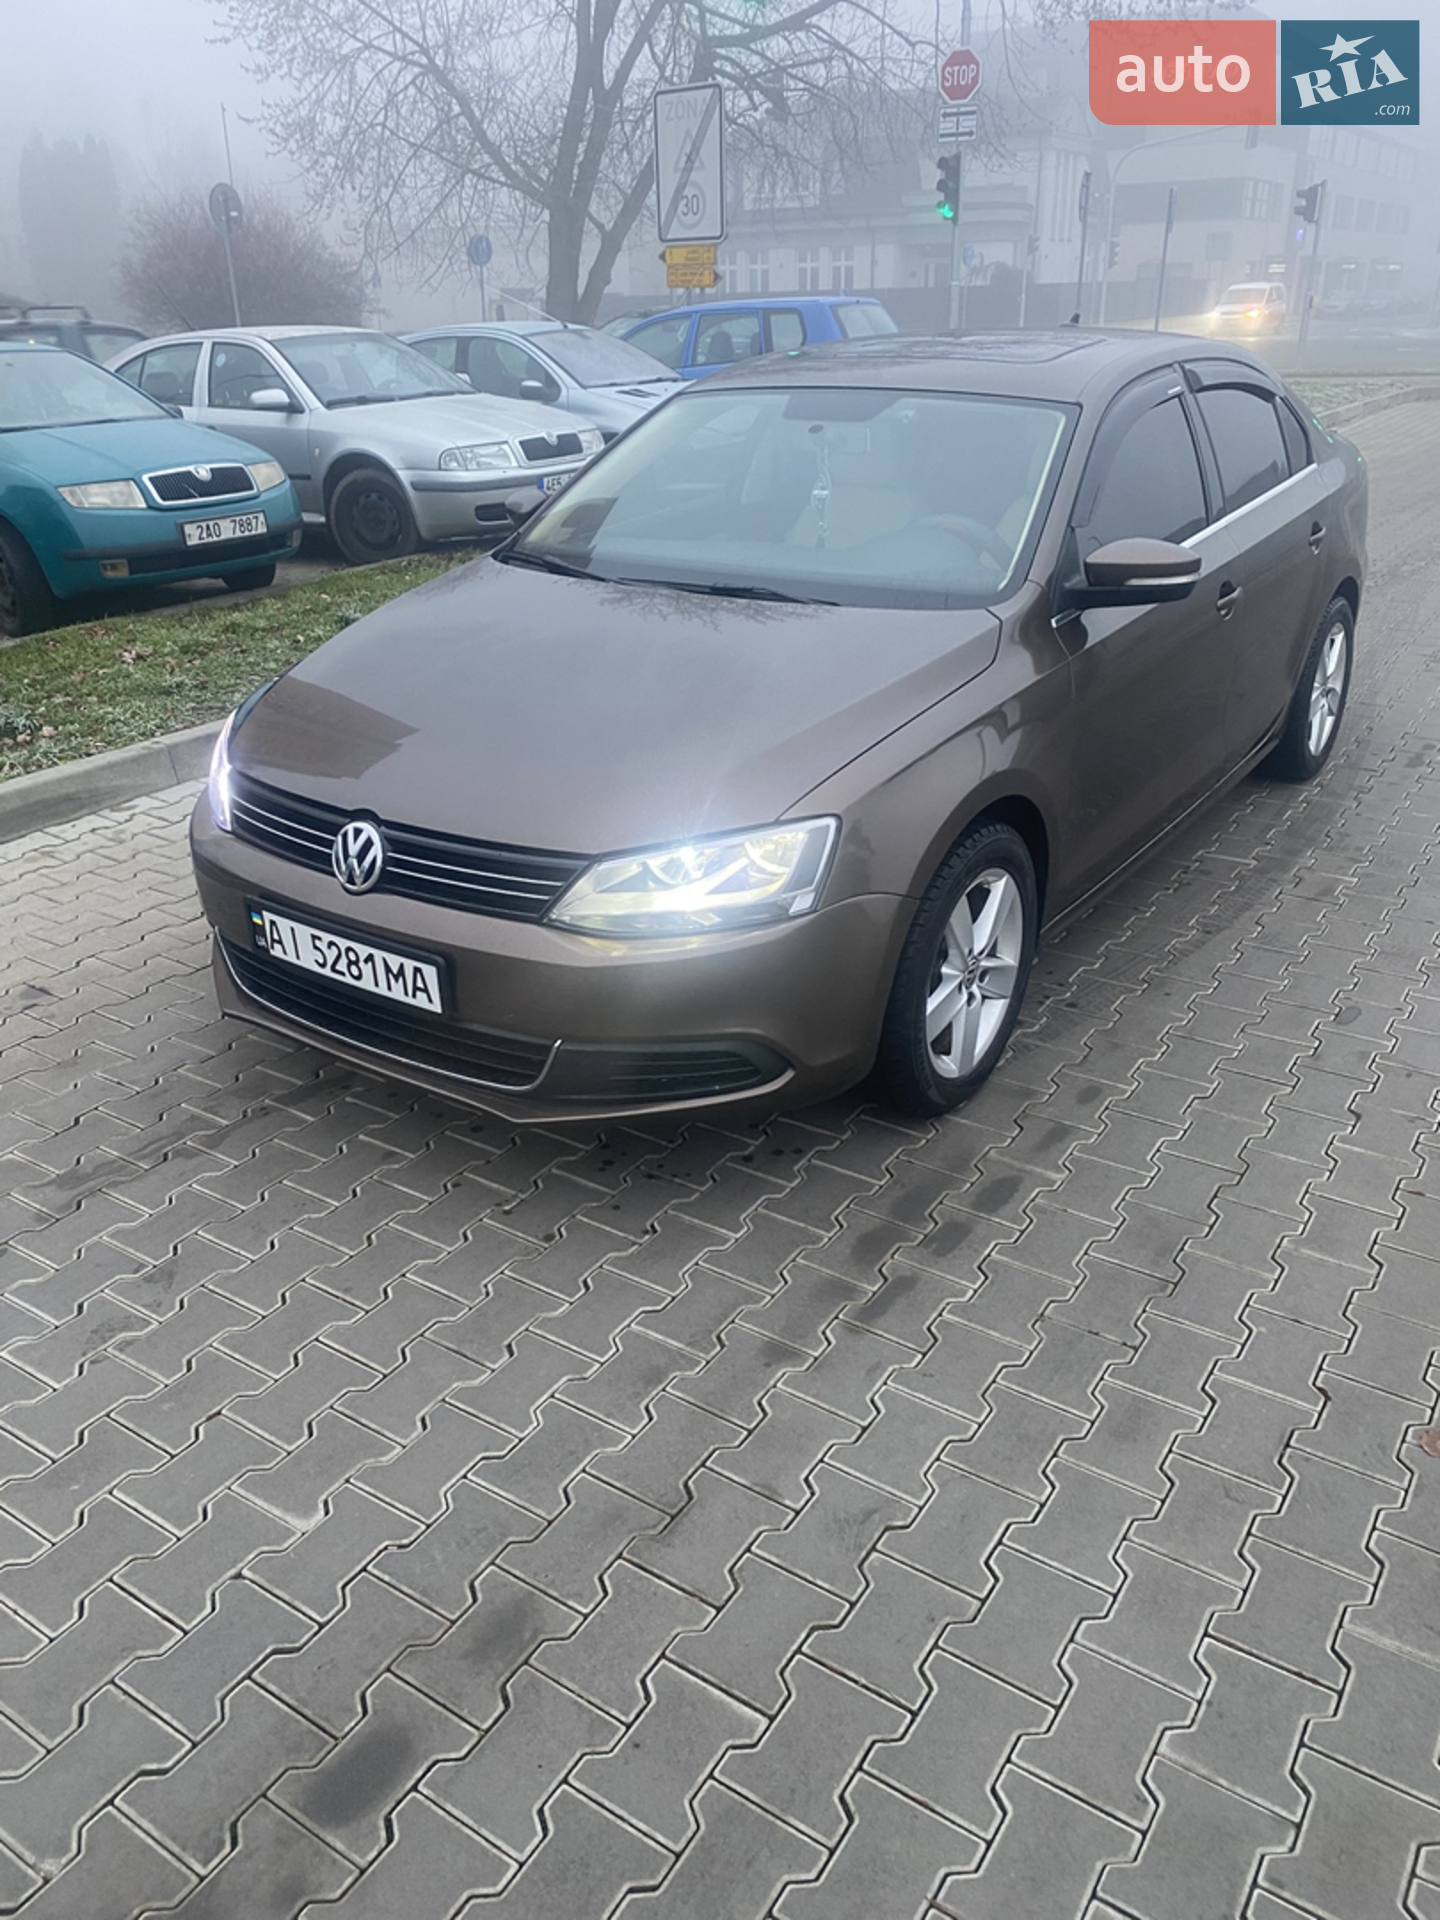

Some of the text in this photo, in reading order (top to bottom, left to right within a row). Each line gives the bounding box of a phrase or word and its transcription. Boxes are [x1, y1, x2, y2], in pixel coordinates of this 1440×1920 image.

[943, 64, 977, 87] STOP
[680, 193, 700, 217] 30
[230, 515, 259, 536] 7887
[332, 821, 383, 893] VW
[310, 933, 380, 988] 5281
[382, 956, 435, 1004] MA
